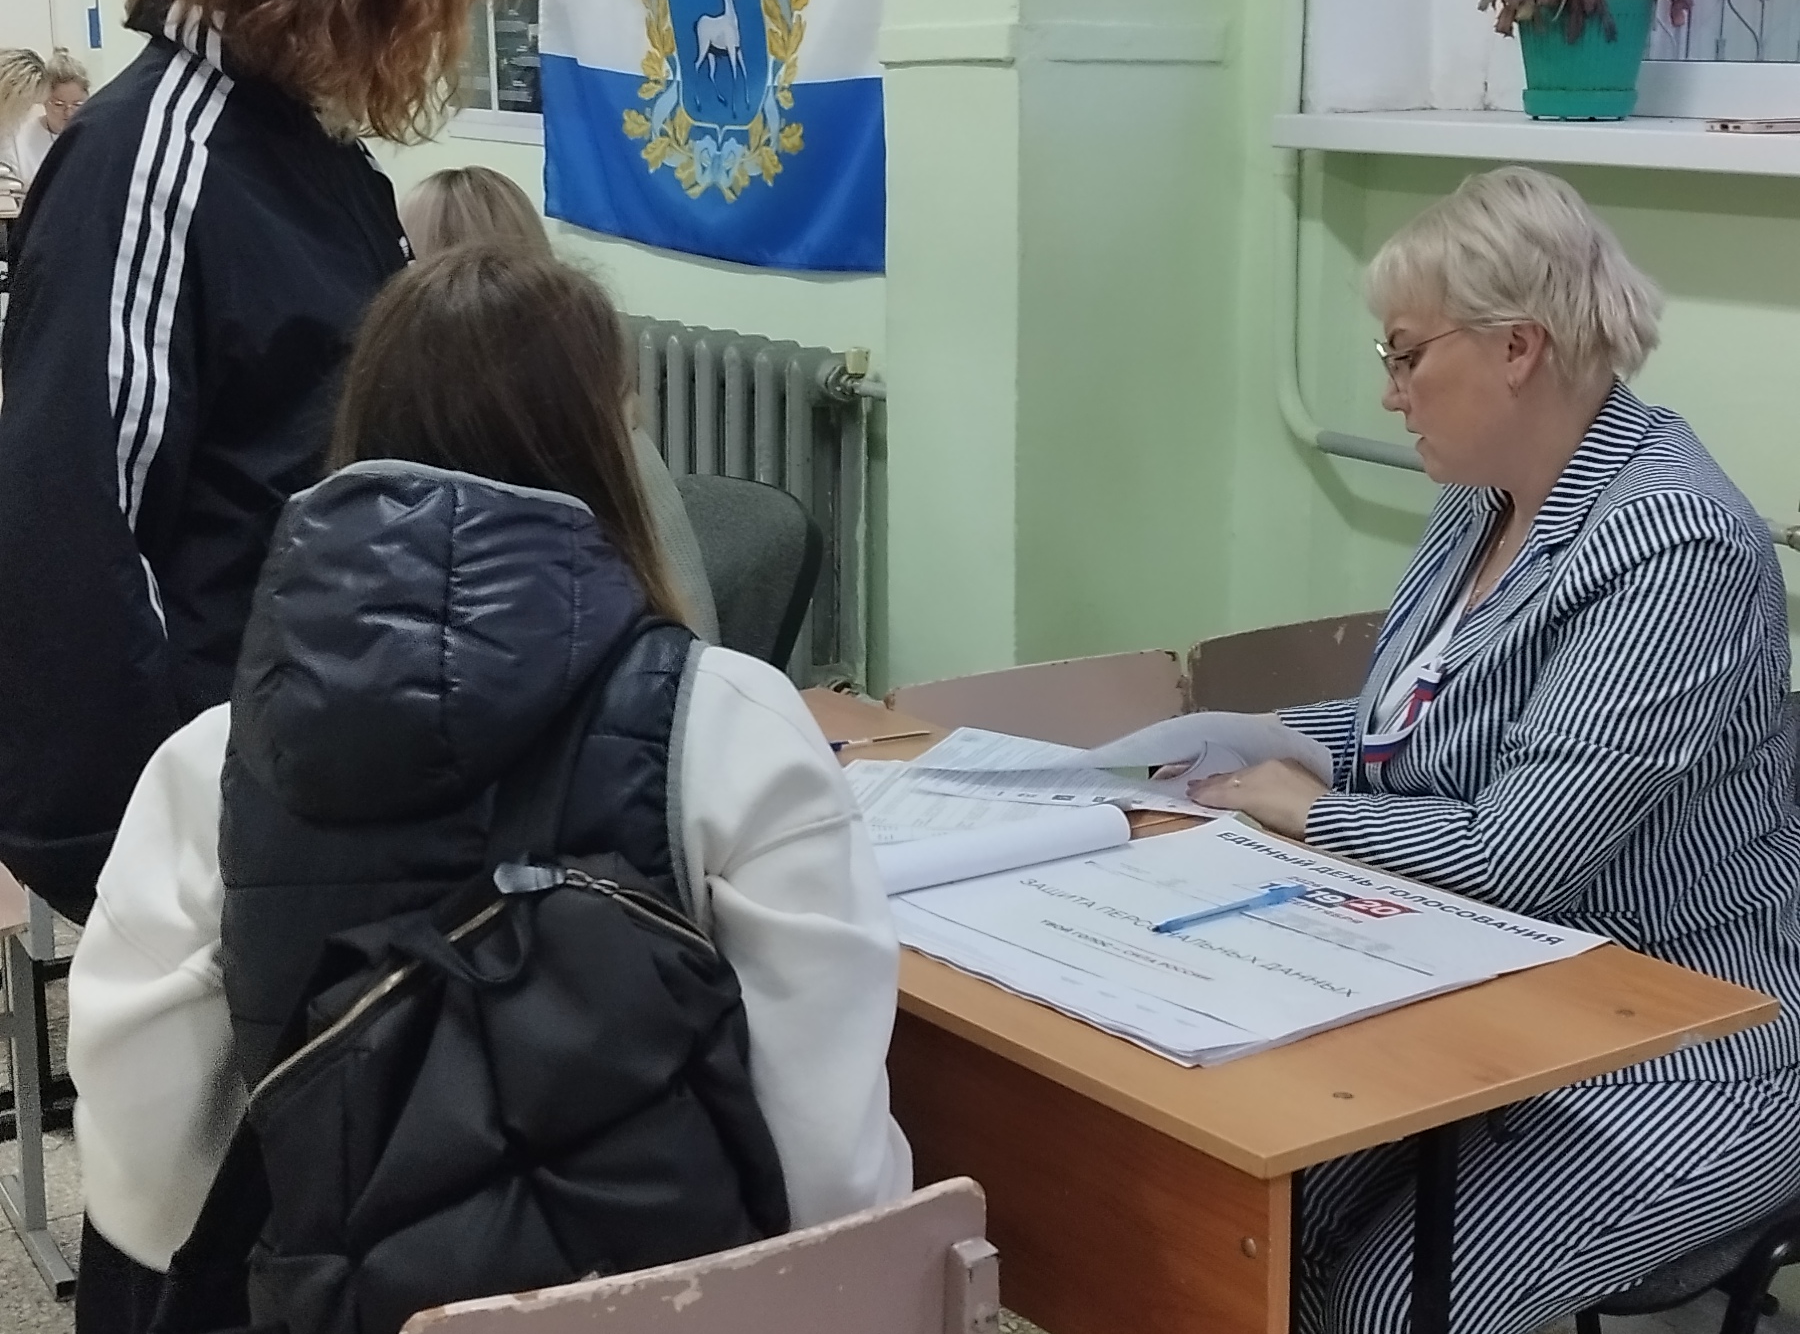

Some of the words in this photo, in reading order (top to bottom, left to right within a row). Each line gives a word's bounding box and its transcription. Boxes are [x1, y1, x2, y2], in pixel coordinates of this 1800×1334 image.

[1019, 877, 1097, 909] ЗАЩИТА
[1257, 962, 1361, 998] ДАННЫХ
[1216, 830, 1317, 869] ЕДИНЫЙ
[1308, 866, 1374, 887] ДЕНЬ
[1375, 884, 1565, 946] ГОЛОСОВАНИЯ
[1304, 890, 1347, 904] 19
[1349, 899, 1402, 917] 20
